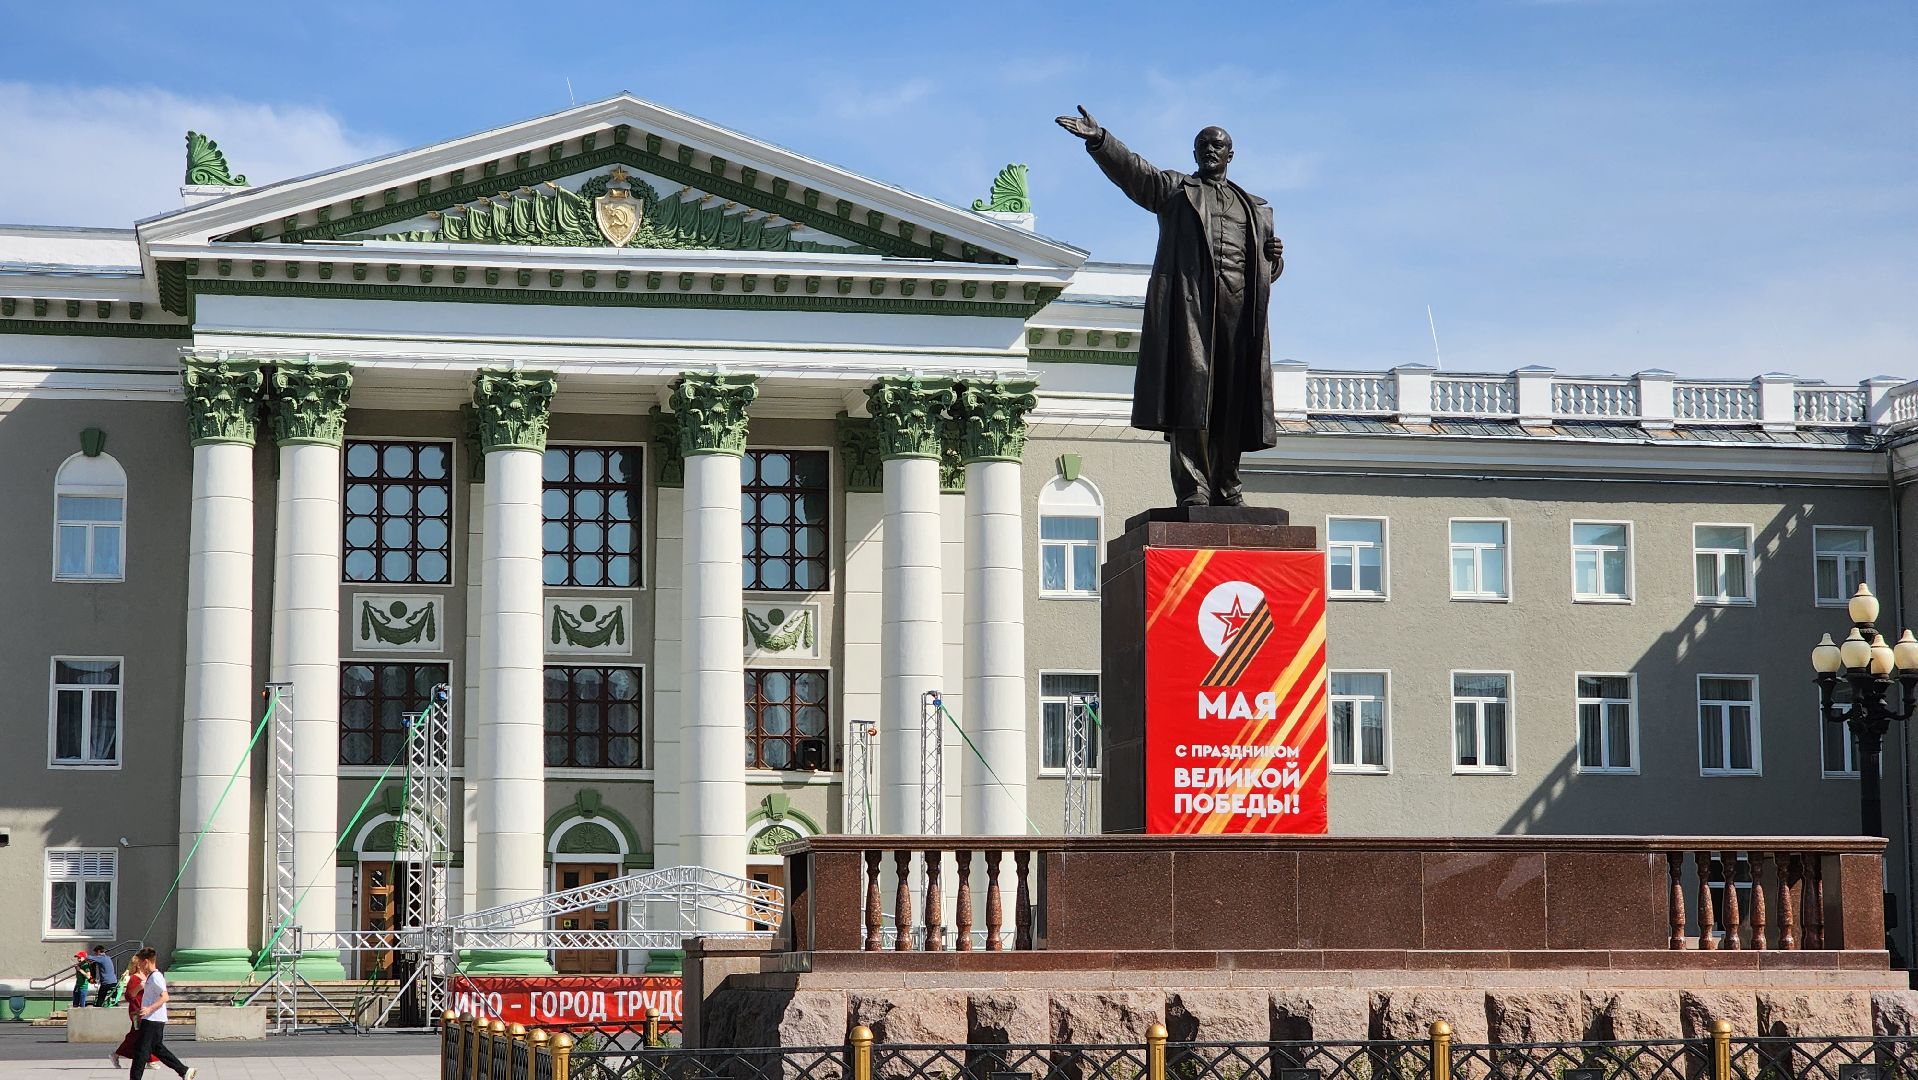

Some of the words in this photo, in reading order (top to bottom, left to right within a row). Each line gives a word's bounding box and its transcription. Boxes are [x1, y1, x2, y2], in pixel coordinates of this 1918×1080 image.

[1198, 690, 1276, 720] МАЯ
[1175, 744, 1187, 758] С
[1191, 744, 1300, 760] ПРАЗДНИКОМ
[1174, 761, 1300, 788] ВЕЛИКОЙ
[1174, 793, 1300, 818] ПОБЕДЫ!
[446, 991, 503, 1018] ИНО
[530, 991, 607, 1022] ГОРОД
